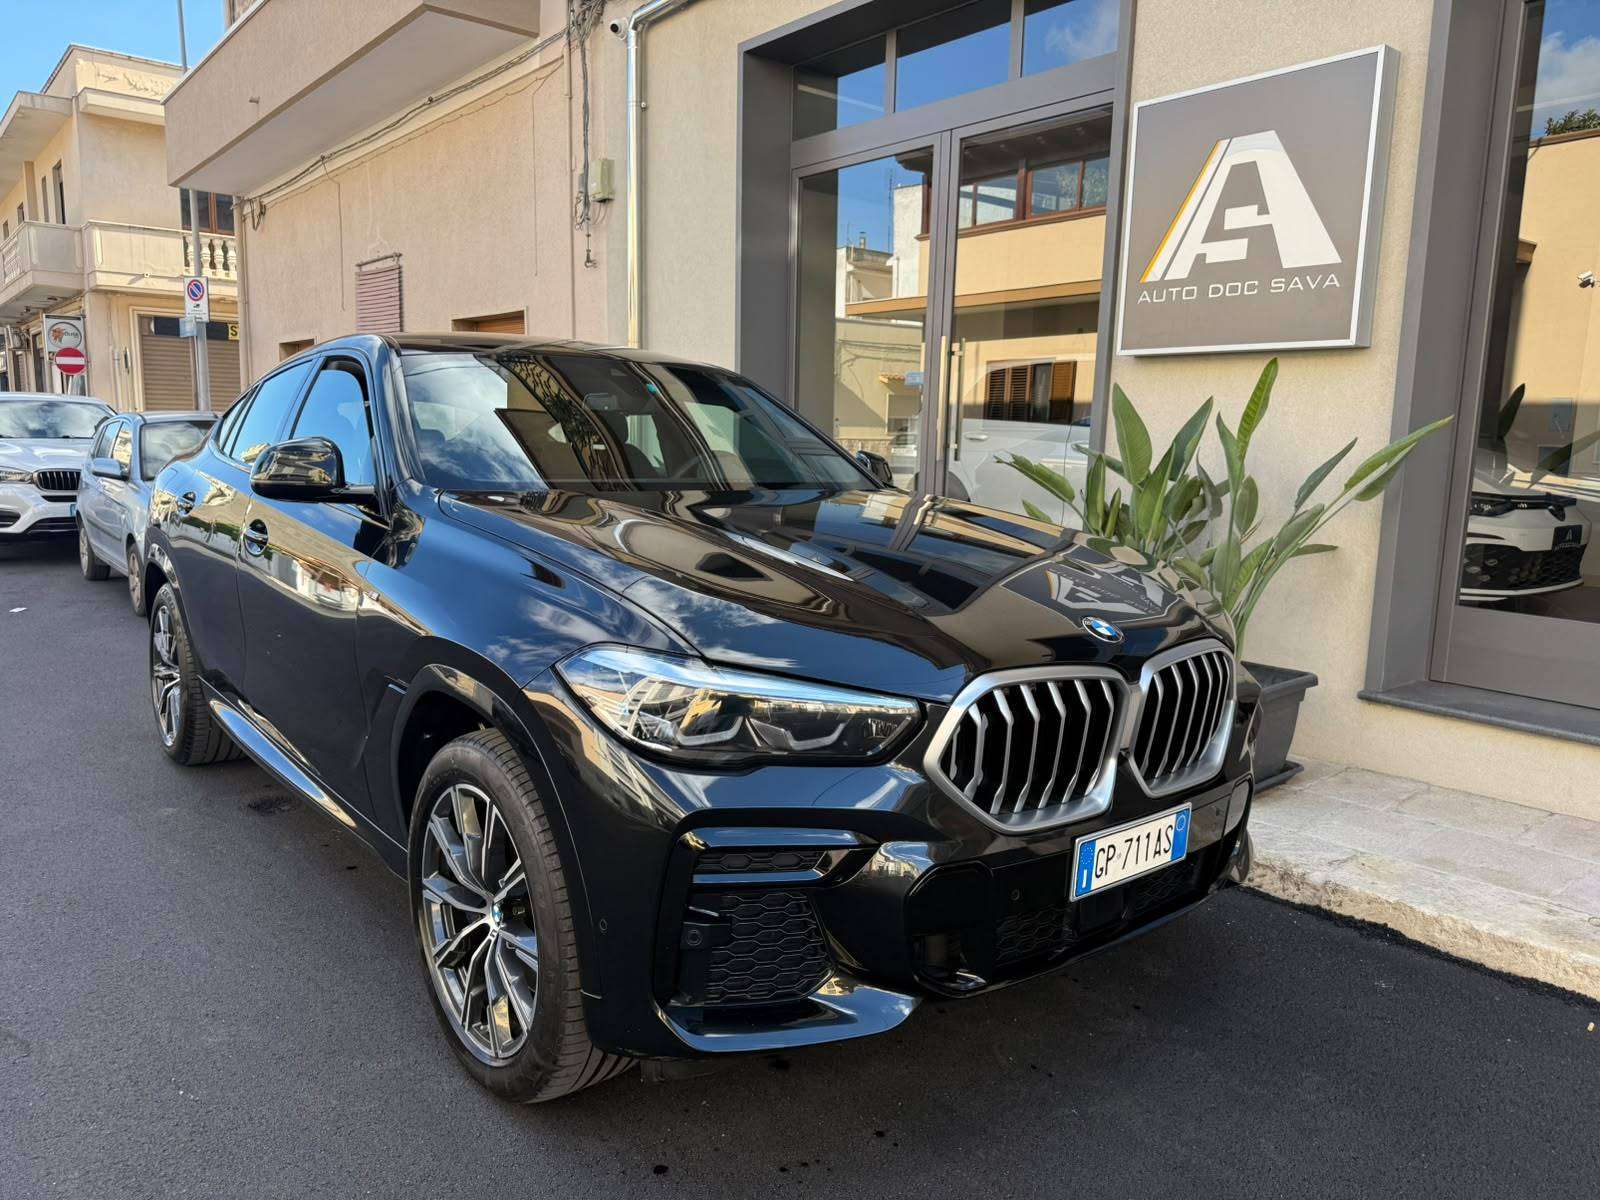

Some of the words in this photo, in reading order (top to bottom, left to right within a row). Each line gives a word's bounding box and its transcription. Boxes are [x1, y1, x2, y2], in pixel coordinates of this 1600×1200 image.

[1137, 286, 1198, 305] AUTO
[1208, 281, 1259, 298] DOC
[1270, 273, 1341, 293] SAVA
[1095, 844, 1116, 879] GP
